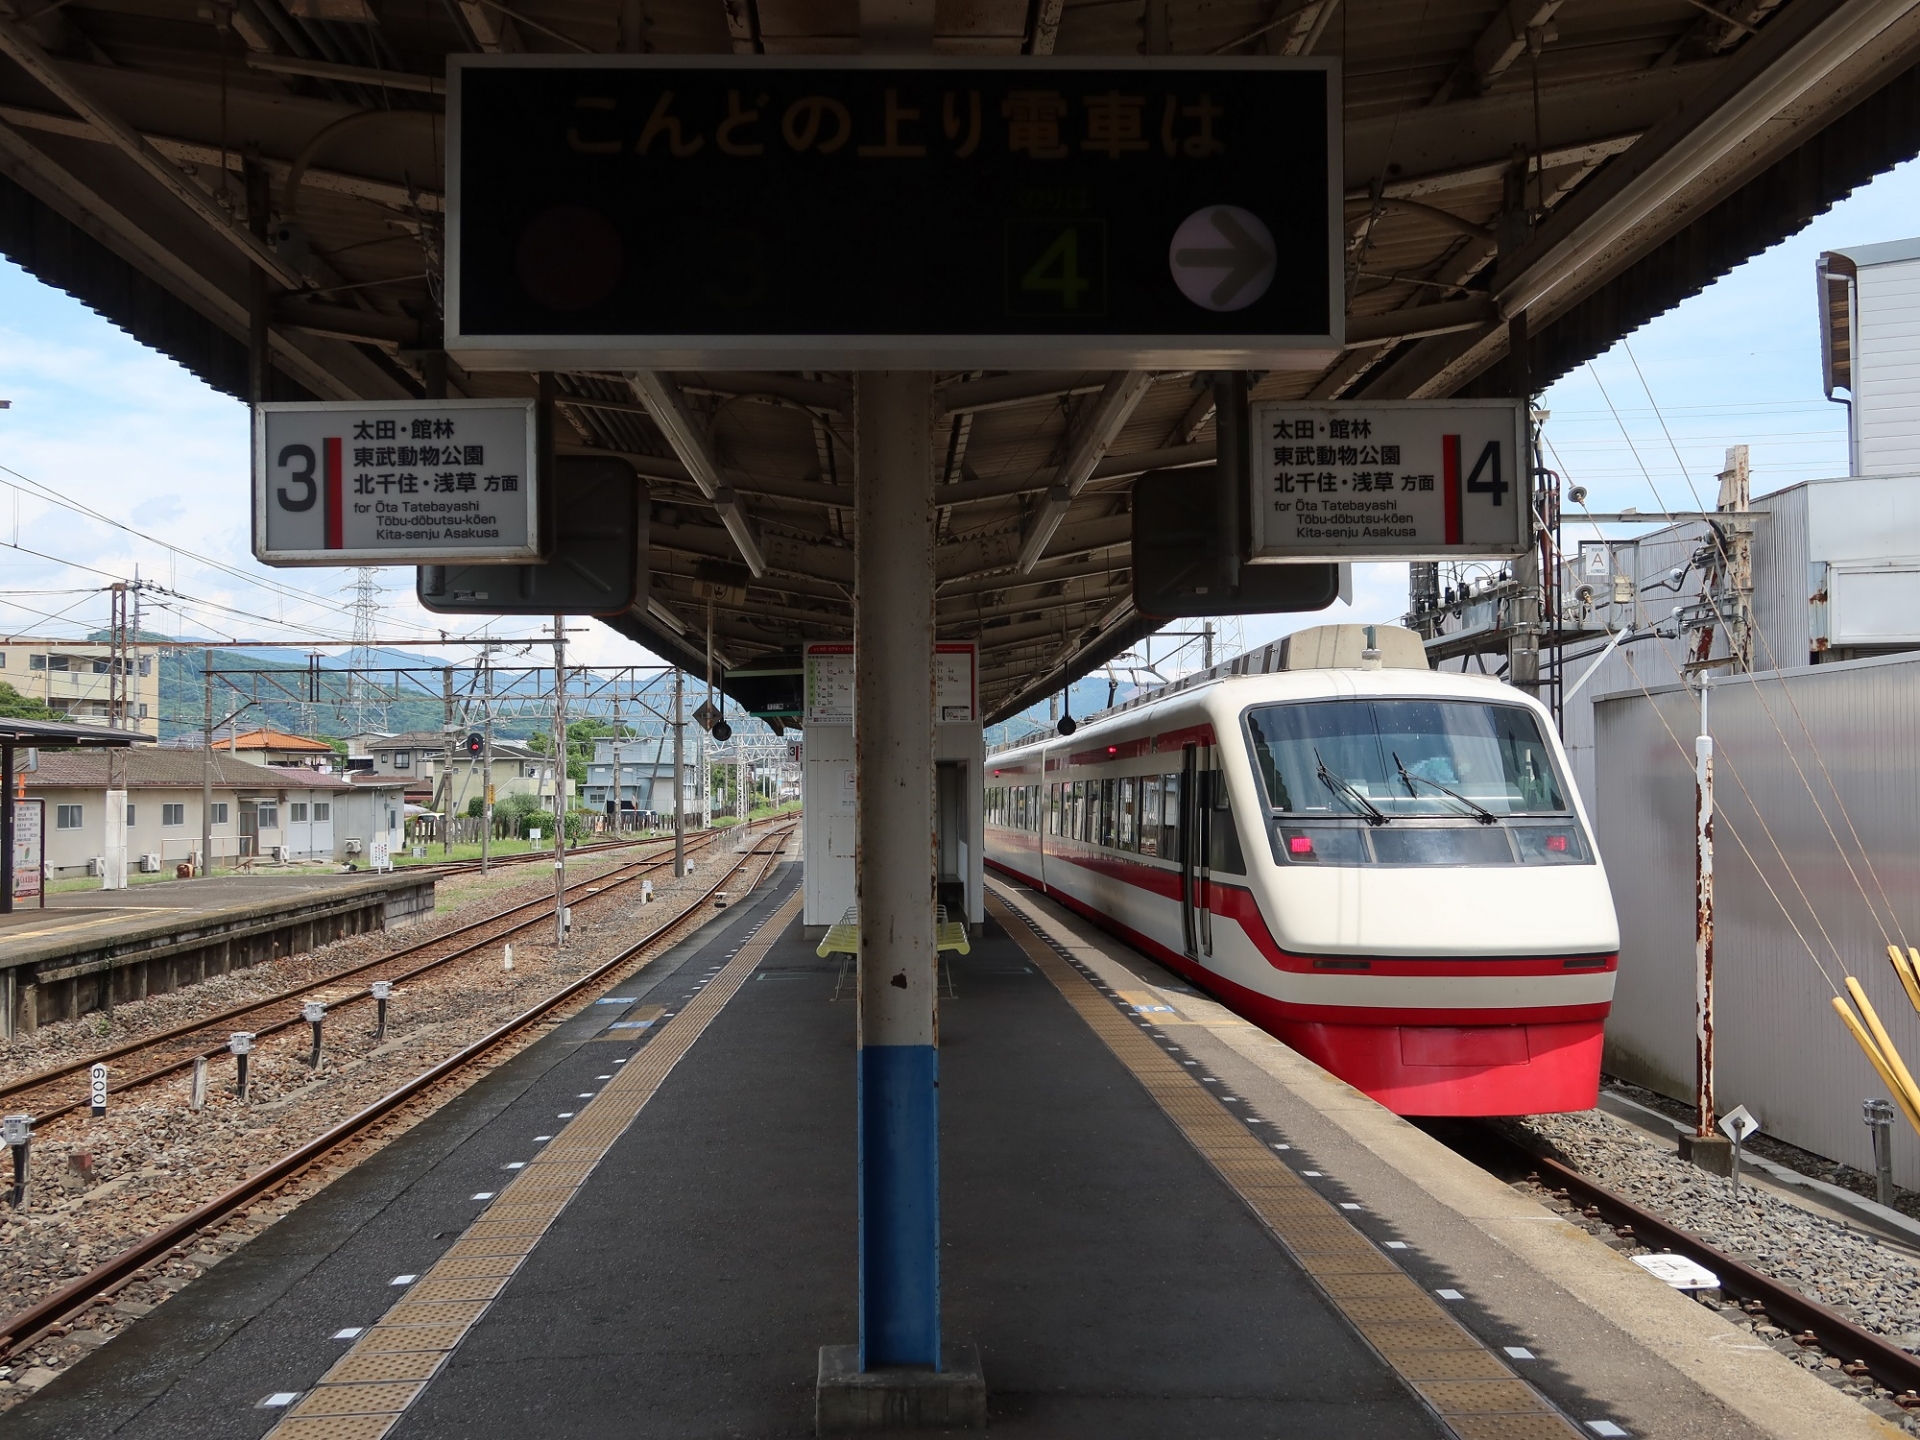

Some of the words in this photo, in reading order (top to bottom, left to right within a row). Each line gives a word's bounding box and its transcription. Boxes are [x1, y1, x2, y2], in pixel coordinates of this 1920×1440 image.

[566, 88, 1228, 161] こんどの上り電車は
[1020, 227, 1090, 311] 4
[353, 418, 454, 440] 太田・館林
[1272, 419, 1371, 440] 太田・館林
[353, 445, 484, 467] 東武動物公園
[1273, 445, 1401, 466] 東武動物公園
[277, 444, 317, 512] 3
[353, 472, 477, 495] 北千住・浅草
[483, 475, 519, 493] 方面
[1274, 472, 1394, 493] 北千住・浅草
[1401, 475, 1434, 492] 方面
[1467, 440, 1508, 506] 4
[354, 503, 371, 513] for
[375, 501, 398, 513] Ōta
[402, 502, 479, 514] Tatebayashi
[1274, 501, 1292, 511] for
[1295, 499, 1318, 511] Ōta
[1321, 500, 1397, 512] Tatebayashi
[376, 529, 440, 541] Kita-senju
[443, 528, 499, 539] Asakusa
[1296, 527, 1359, 539] Kita-senju
[1362, 526, 1417, 538] Asakusa
[1591, 553, 1604, 567] A
[789, 746, 796, 756] 3
